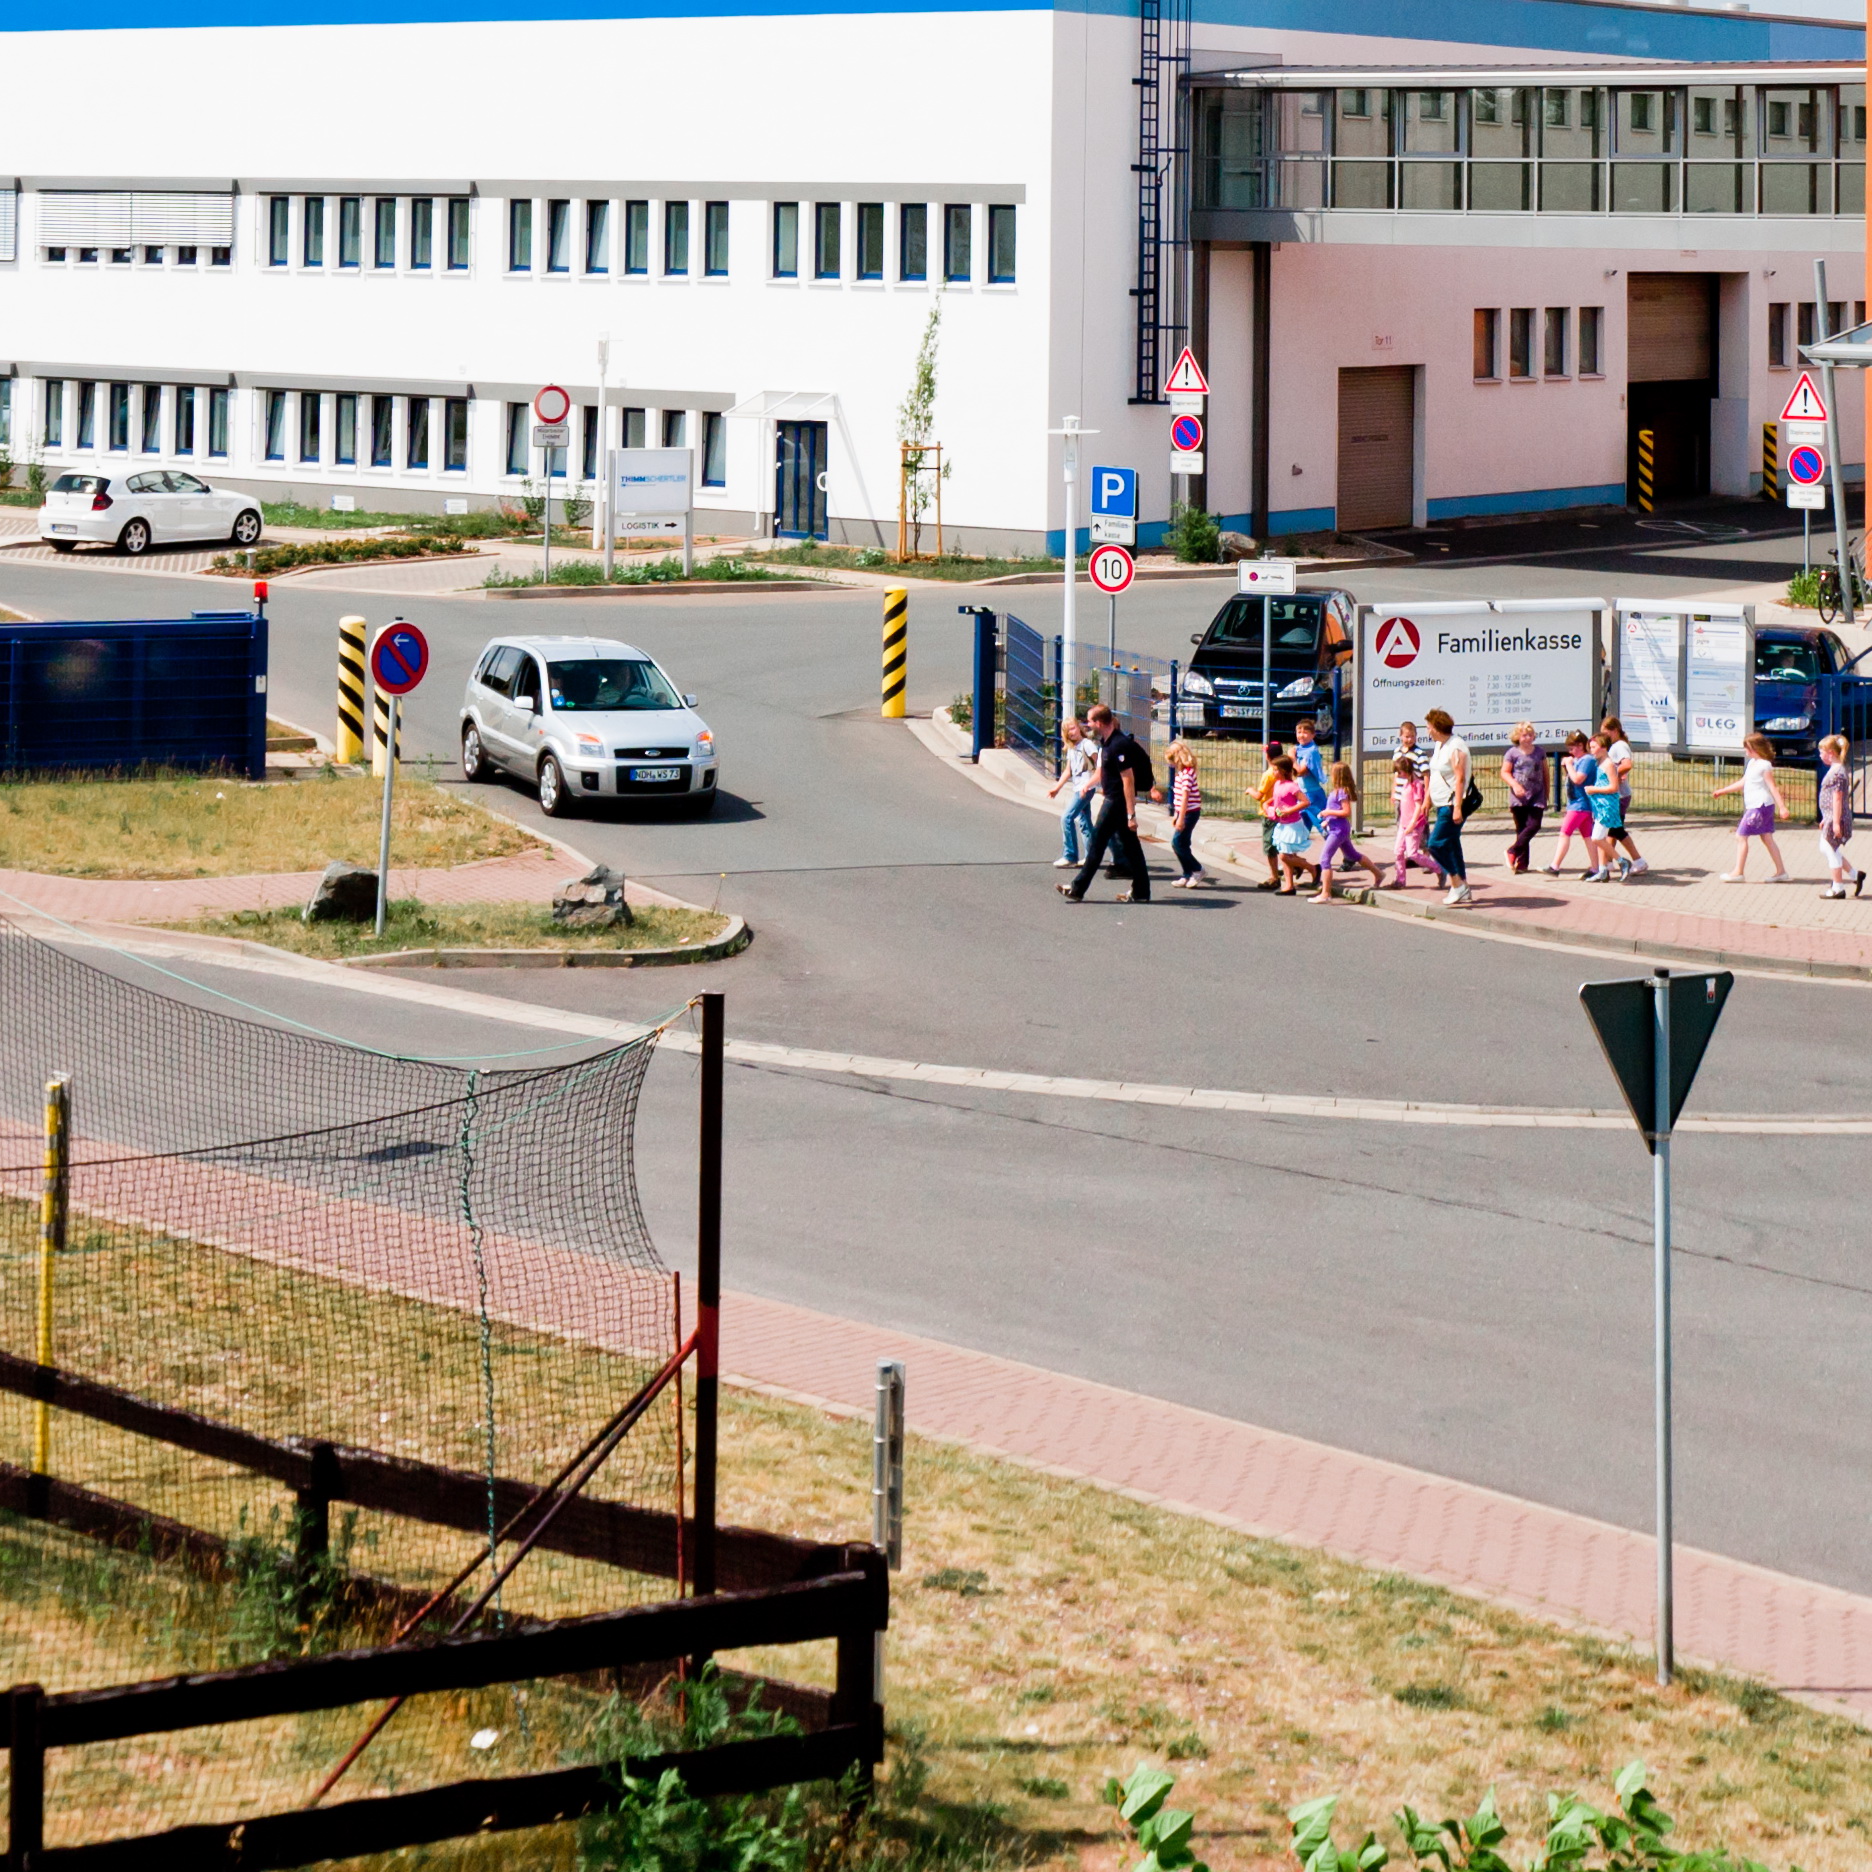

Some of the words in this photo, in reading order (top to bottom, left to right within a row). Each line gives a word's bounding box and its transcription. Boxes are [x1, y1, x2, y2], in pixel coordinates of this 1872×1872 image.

[621, 474, 687, 483] THIMMSCHERTLER
[1101, 473, 1125, 509] P
[622, 522, 660, 530] LOGISTIK
[1102, 558, 1122, 580] 10
[1438, 627, 1582, 654] Familienkasse
[1372, 677, 1446, 689] Öffnungszeiten:
[1707, 718, 1736, 730] LEG
[1372, 736, 1387, 746] Die
[1458, 732, 1494, 741] efindet
[636, 770, 652, 779] NDH
[669, 769, 679, 778] 73
